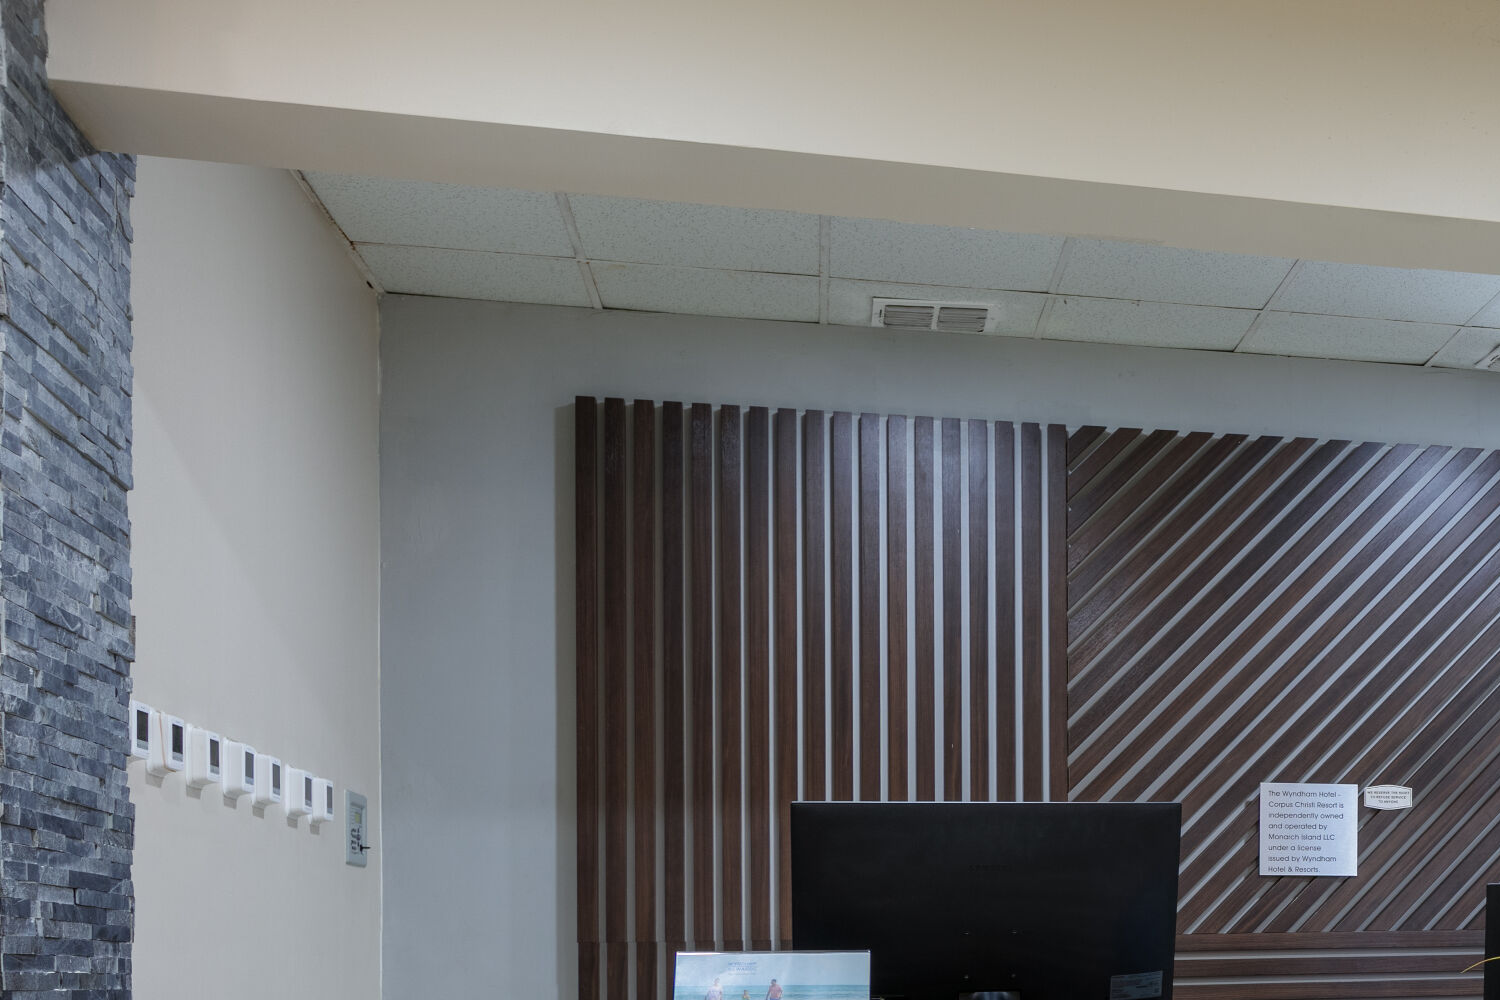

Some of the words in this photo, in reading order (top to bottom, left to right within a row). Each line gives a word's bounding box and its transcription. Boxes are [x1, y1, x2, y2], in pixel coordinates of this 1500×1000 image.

[1281, 790, 1317, 798] Wyndham
[1318, 823, 1328, 831] by
[1291, 855, 1300, 863] by
[1301, 855, 1337, 863] Wyndham
